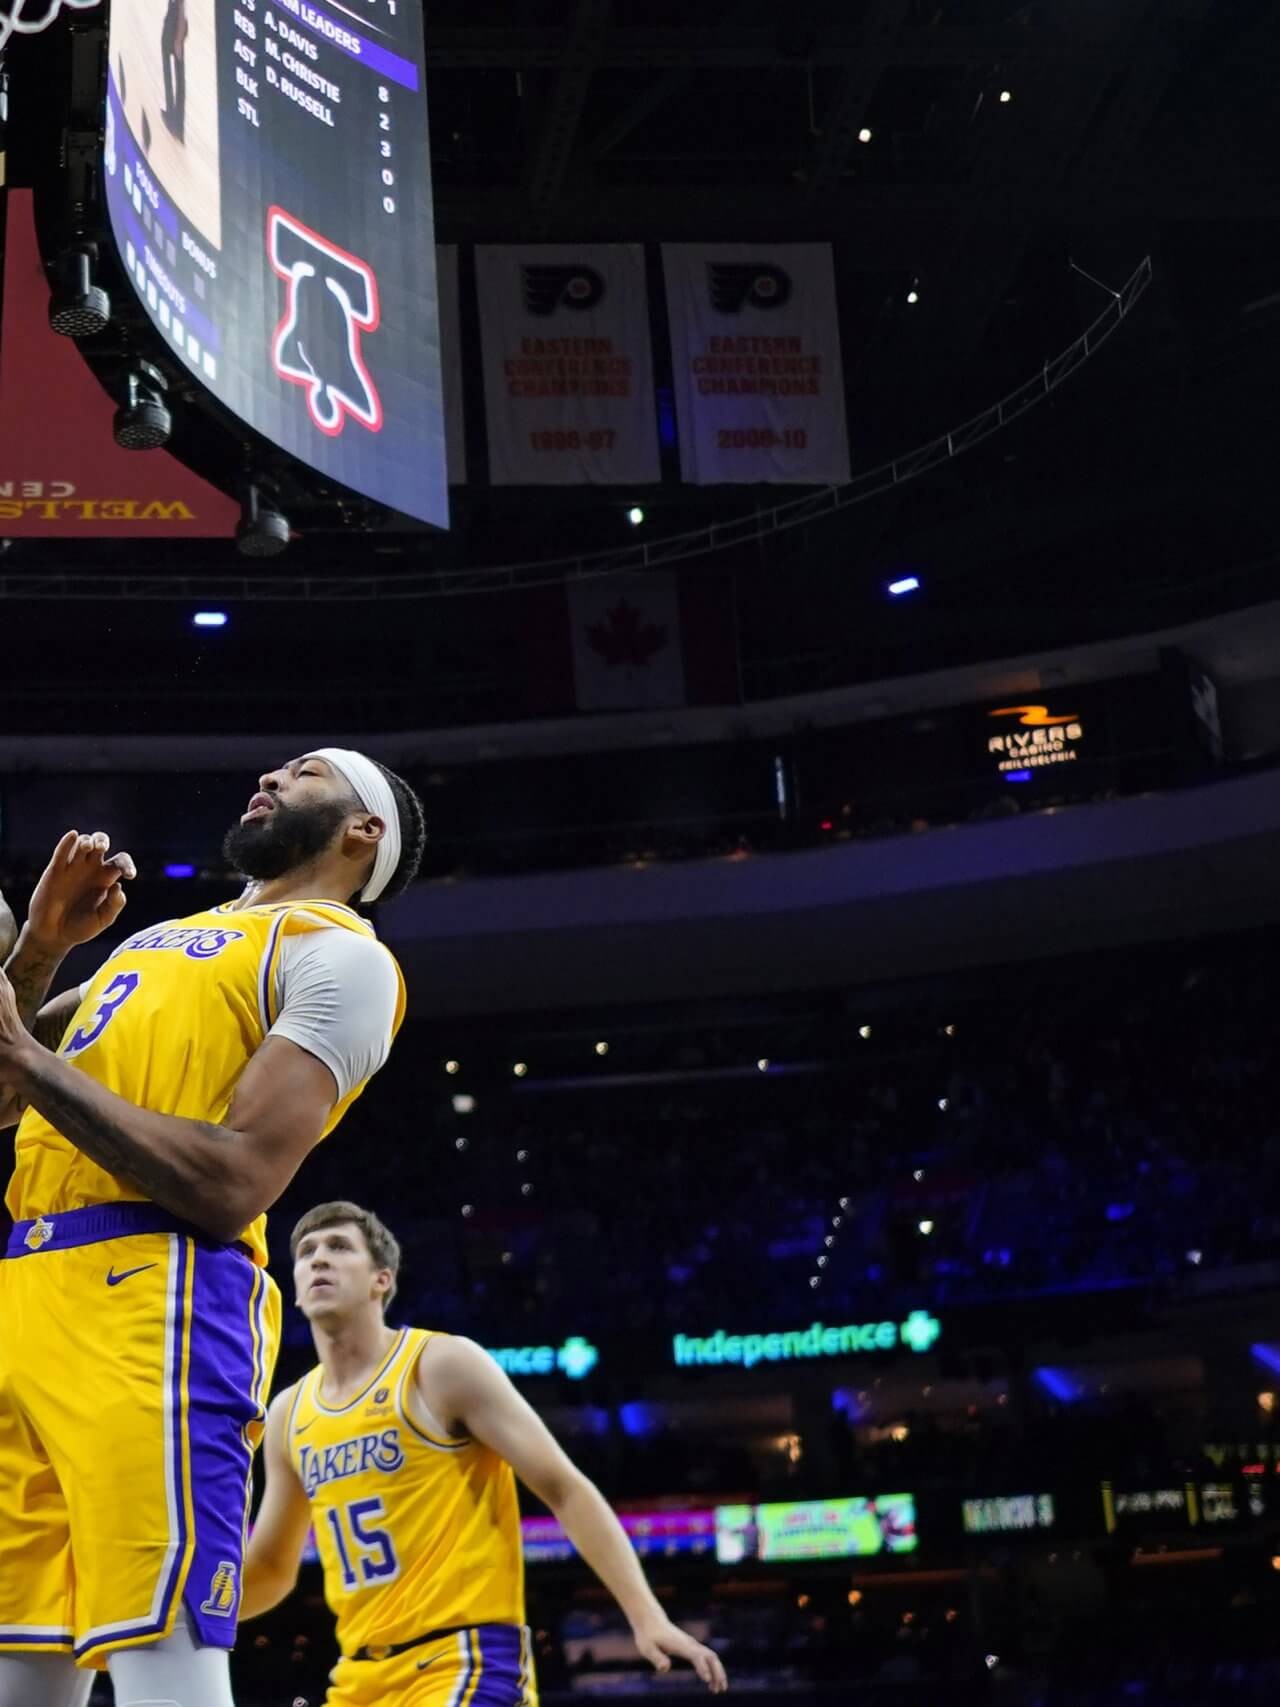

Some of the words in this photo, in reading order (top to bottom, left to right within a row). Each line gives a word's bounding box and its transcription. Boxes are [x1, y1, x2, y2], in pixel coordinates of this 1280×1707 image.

[234, 9, 256, 40] REB
[282, 53, 340, 103] CHRISTIE
[379, 113, 390, 131] 2
[279, 20, 318, 60] DAVIS
[378, 86, 389, 103] 8
[301, 4, 361, 54] LEADERS
[234, 39, 257, 68] AST
[280, 77, 334, 128] RUSSELL
[380, 140, 391, 158] 3
[236, 67, 258, 98] BLK
[382, 169, 393, 186] 0
[237, 97, 259, 128] STL
[383, 197, 395, 214] 0
[989, 723, 1082, 753] RIVERS
[62, 971, 141, 1058] 3
[673, 1320, 897, 1368] Independence
[299, 1428, 405, 1499] LAKERS
[326, 1496, 400, 1592] 15
